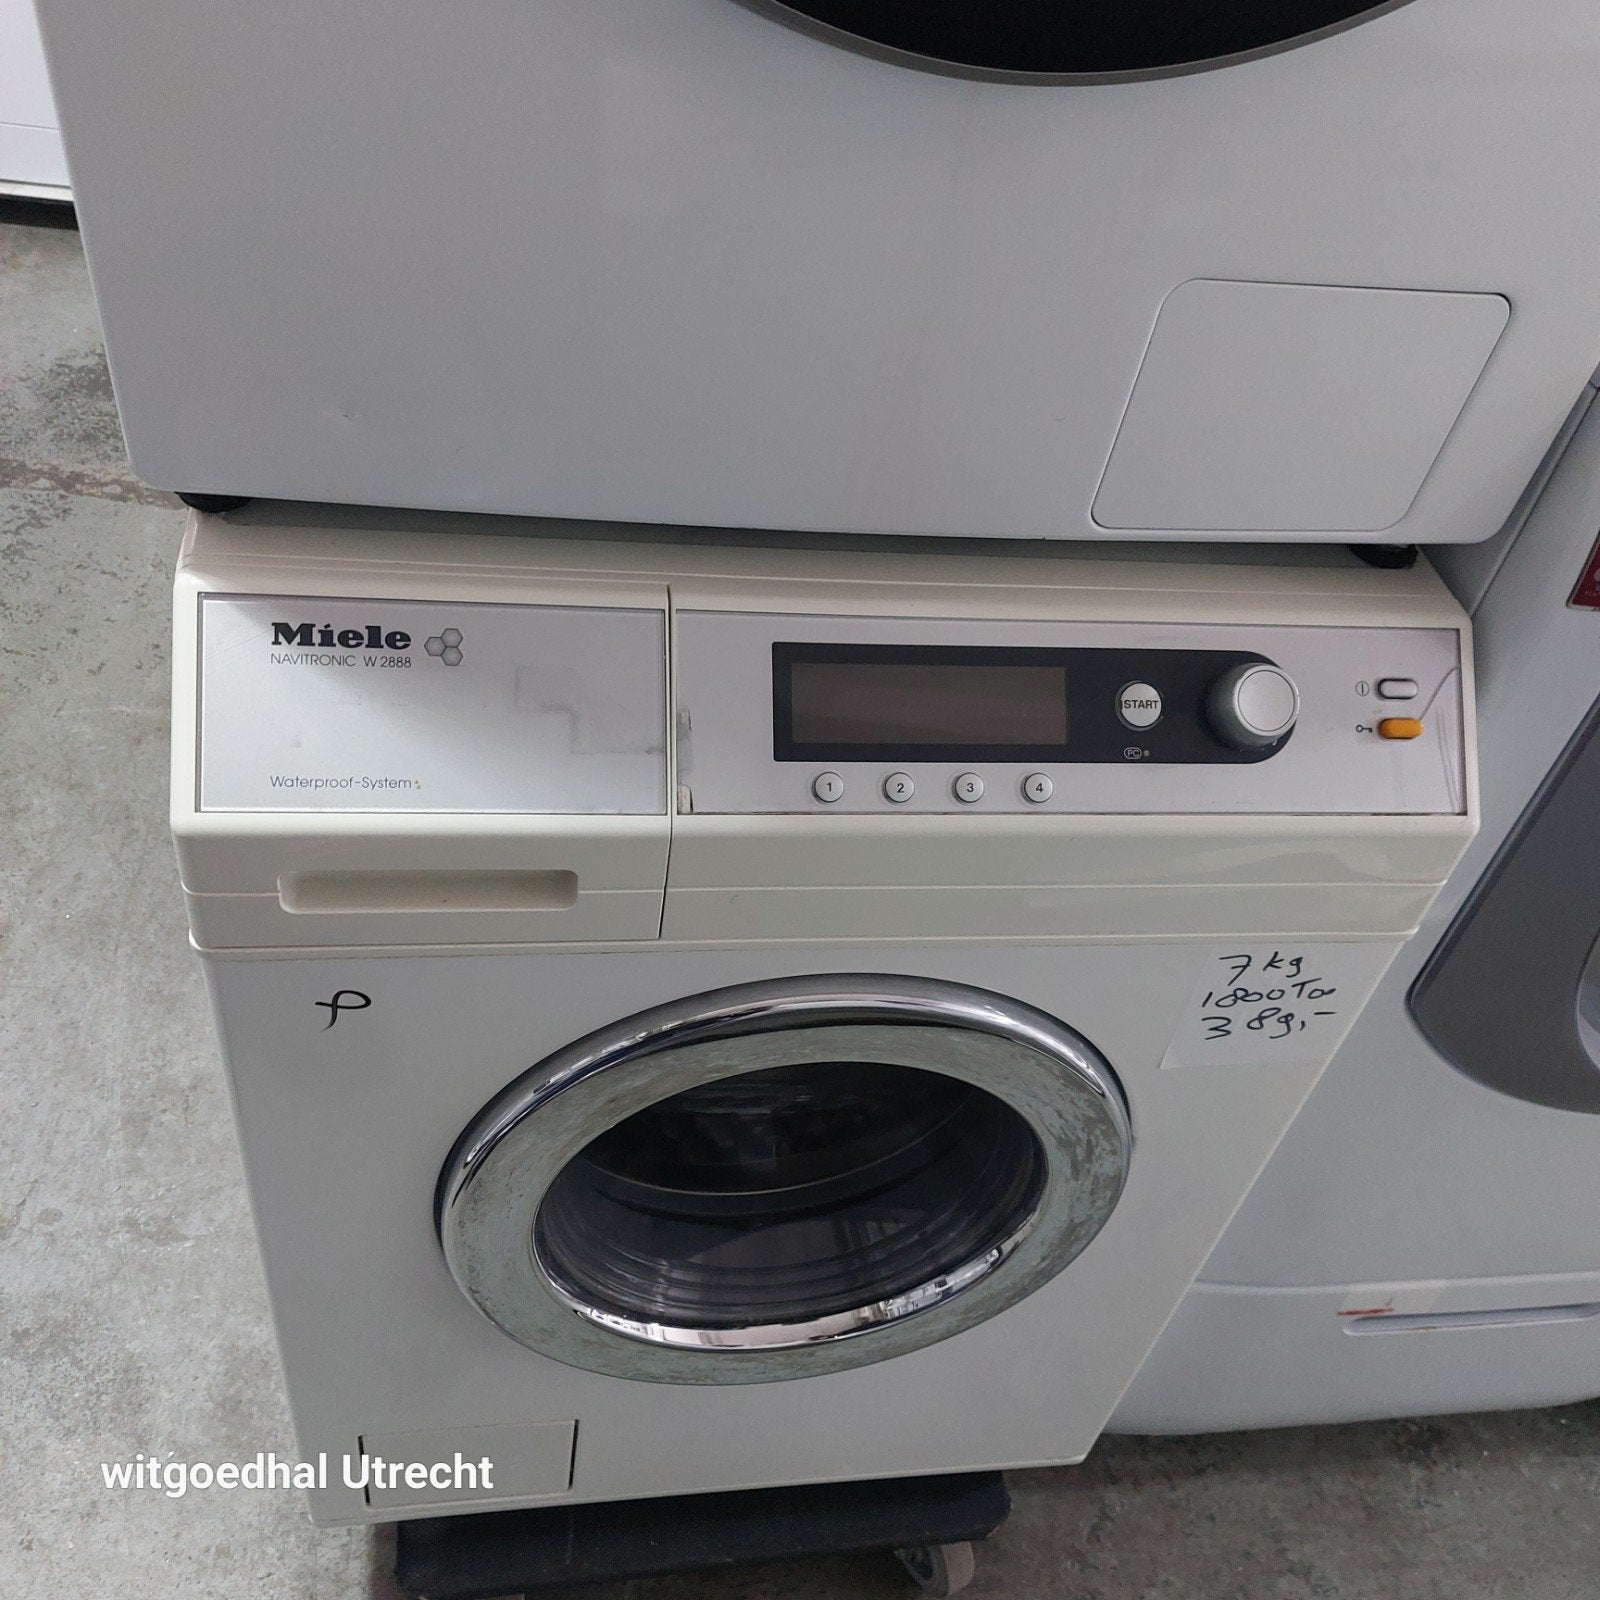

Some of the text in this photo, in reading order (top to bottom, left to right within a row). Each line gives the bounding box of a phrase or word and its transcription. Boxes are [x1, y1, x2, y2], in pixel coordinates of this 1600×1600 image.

[271, 622, 412, 650] Miele
[270, 652, 412, 668] NAVITRONIC W 2888
[1123, 699, 1159, 710] START
[270, 775, 412, 791] Waterproof-System
[826, 781, 833, 793] 1
[896, 782, 905, 794] 2
[966, 782, 975, 793] 3
[1035, 782, 1044, 793] 4
[1219, 951, 1303, 987] 7 kg
